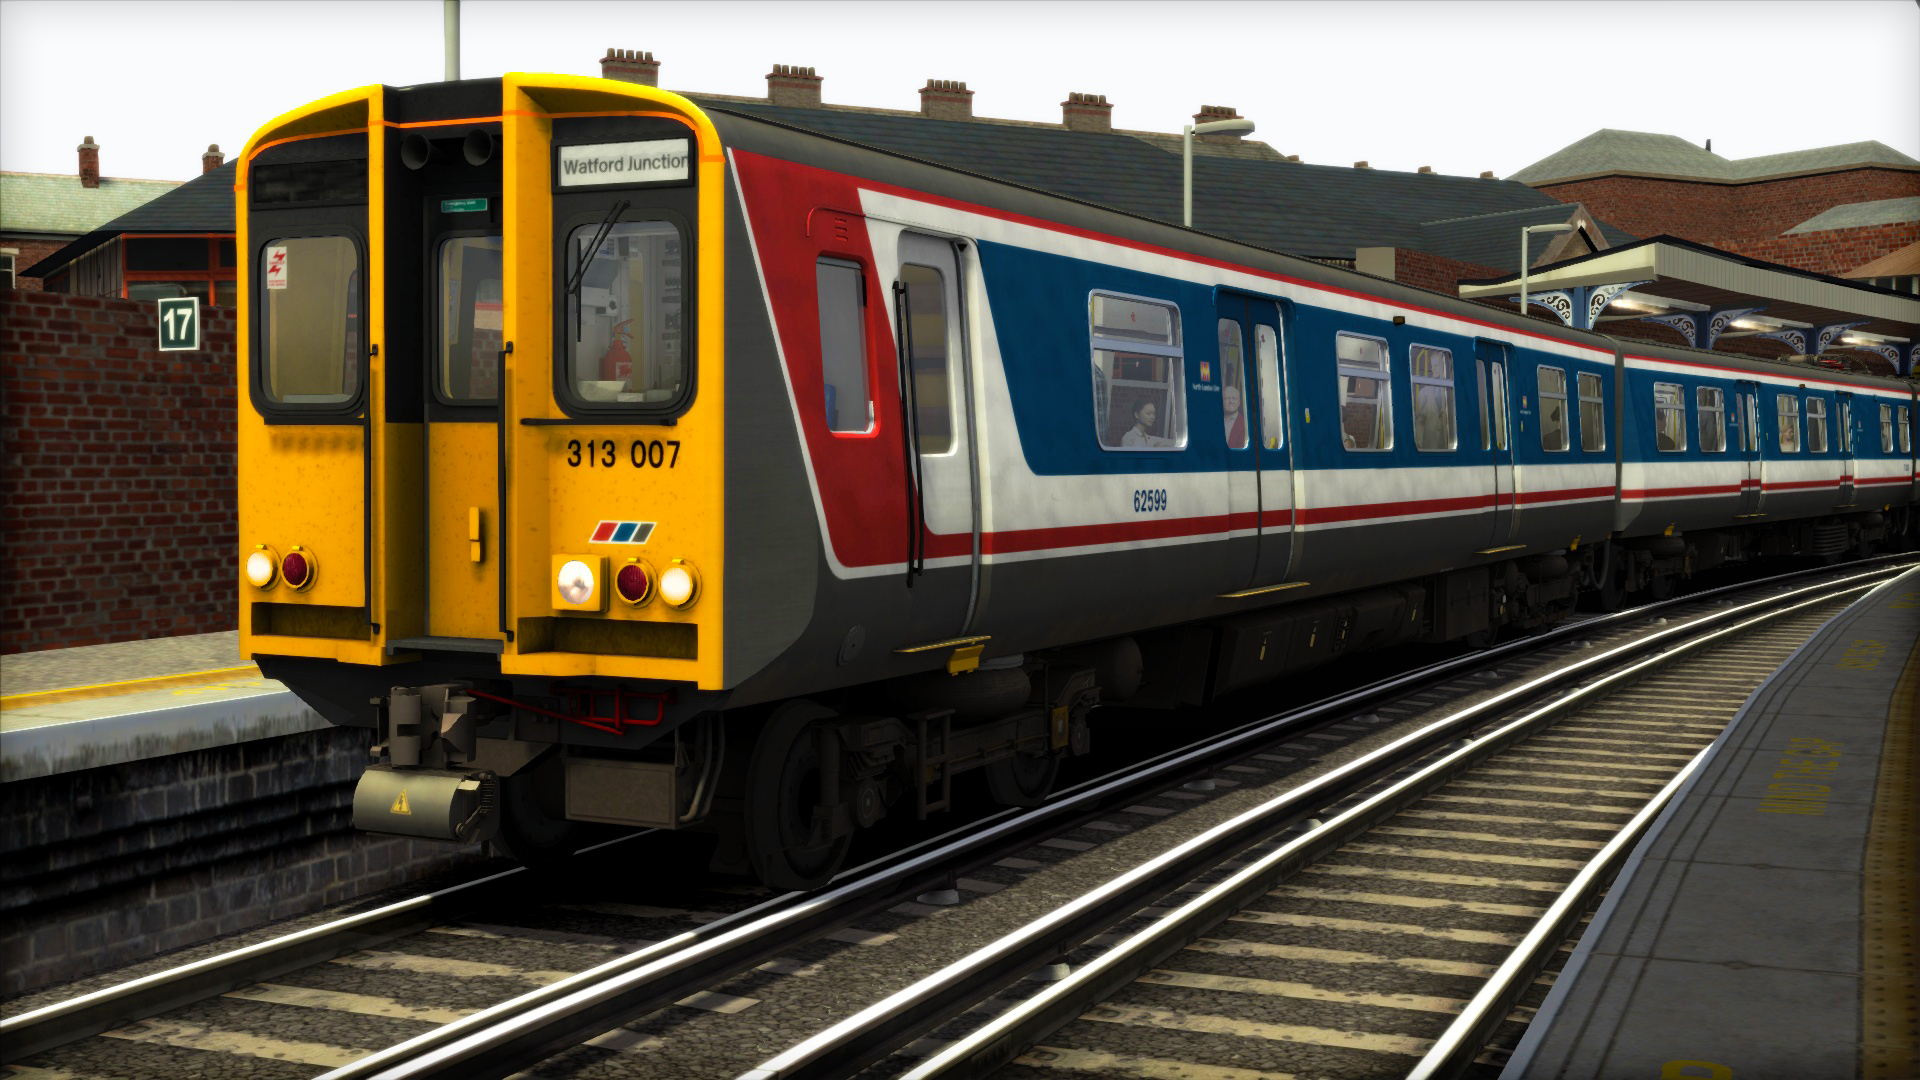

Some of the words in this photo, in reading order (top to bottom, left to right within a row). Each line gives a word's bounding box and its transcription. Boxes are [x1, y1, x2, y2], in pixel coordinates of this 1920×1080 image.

[563, 156, 624, 175] Watford
[628, 153, 689, 172] Junction
[163, 307, 193, 341] 17
[567, 439, 616, 468] 313
[630, 440, 681, 469] 007
[1133, 488, 1167, 513] 62599
